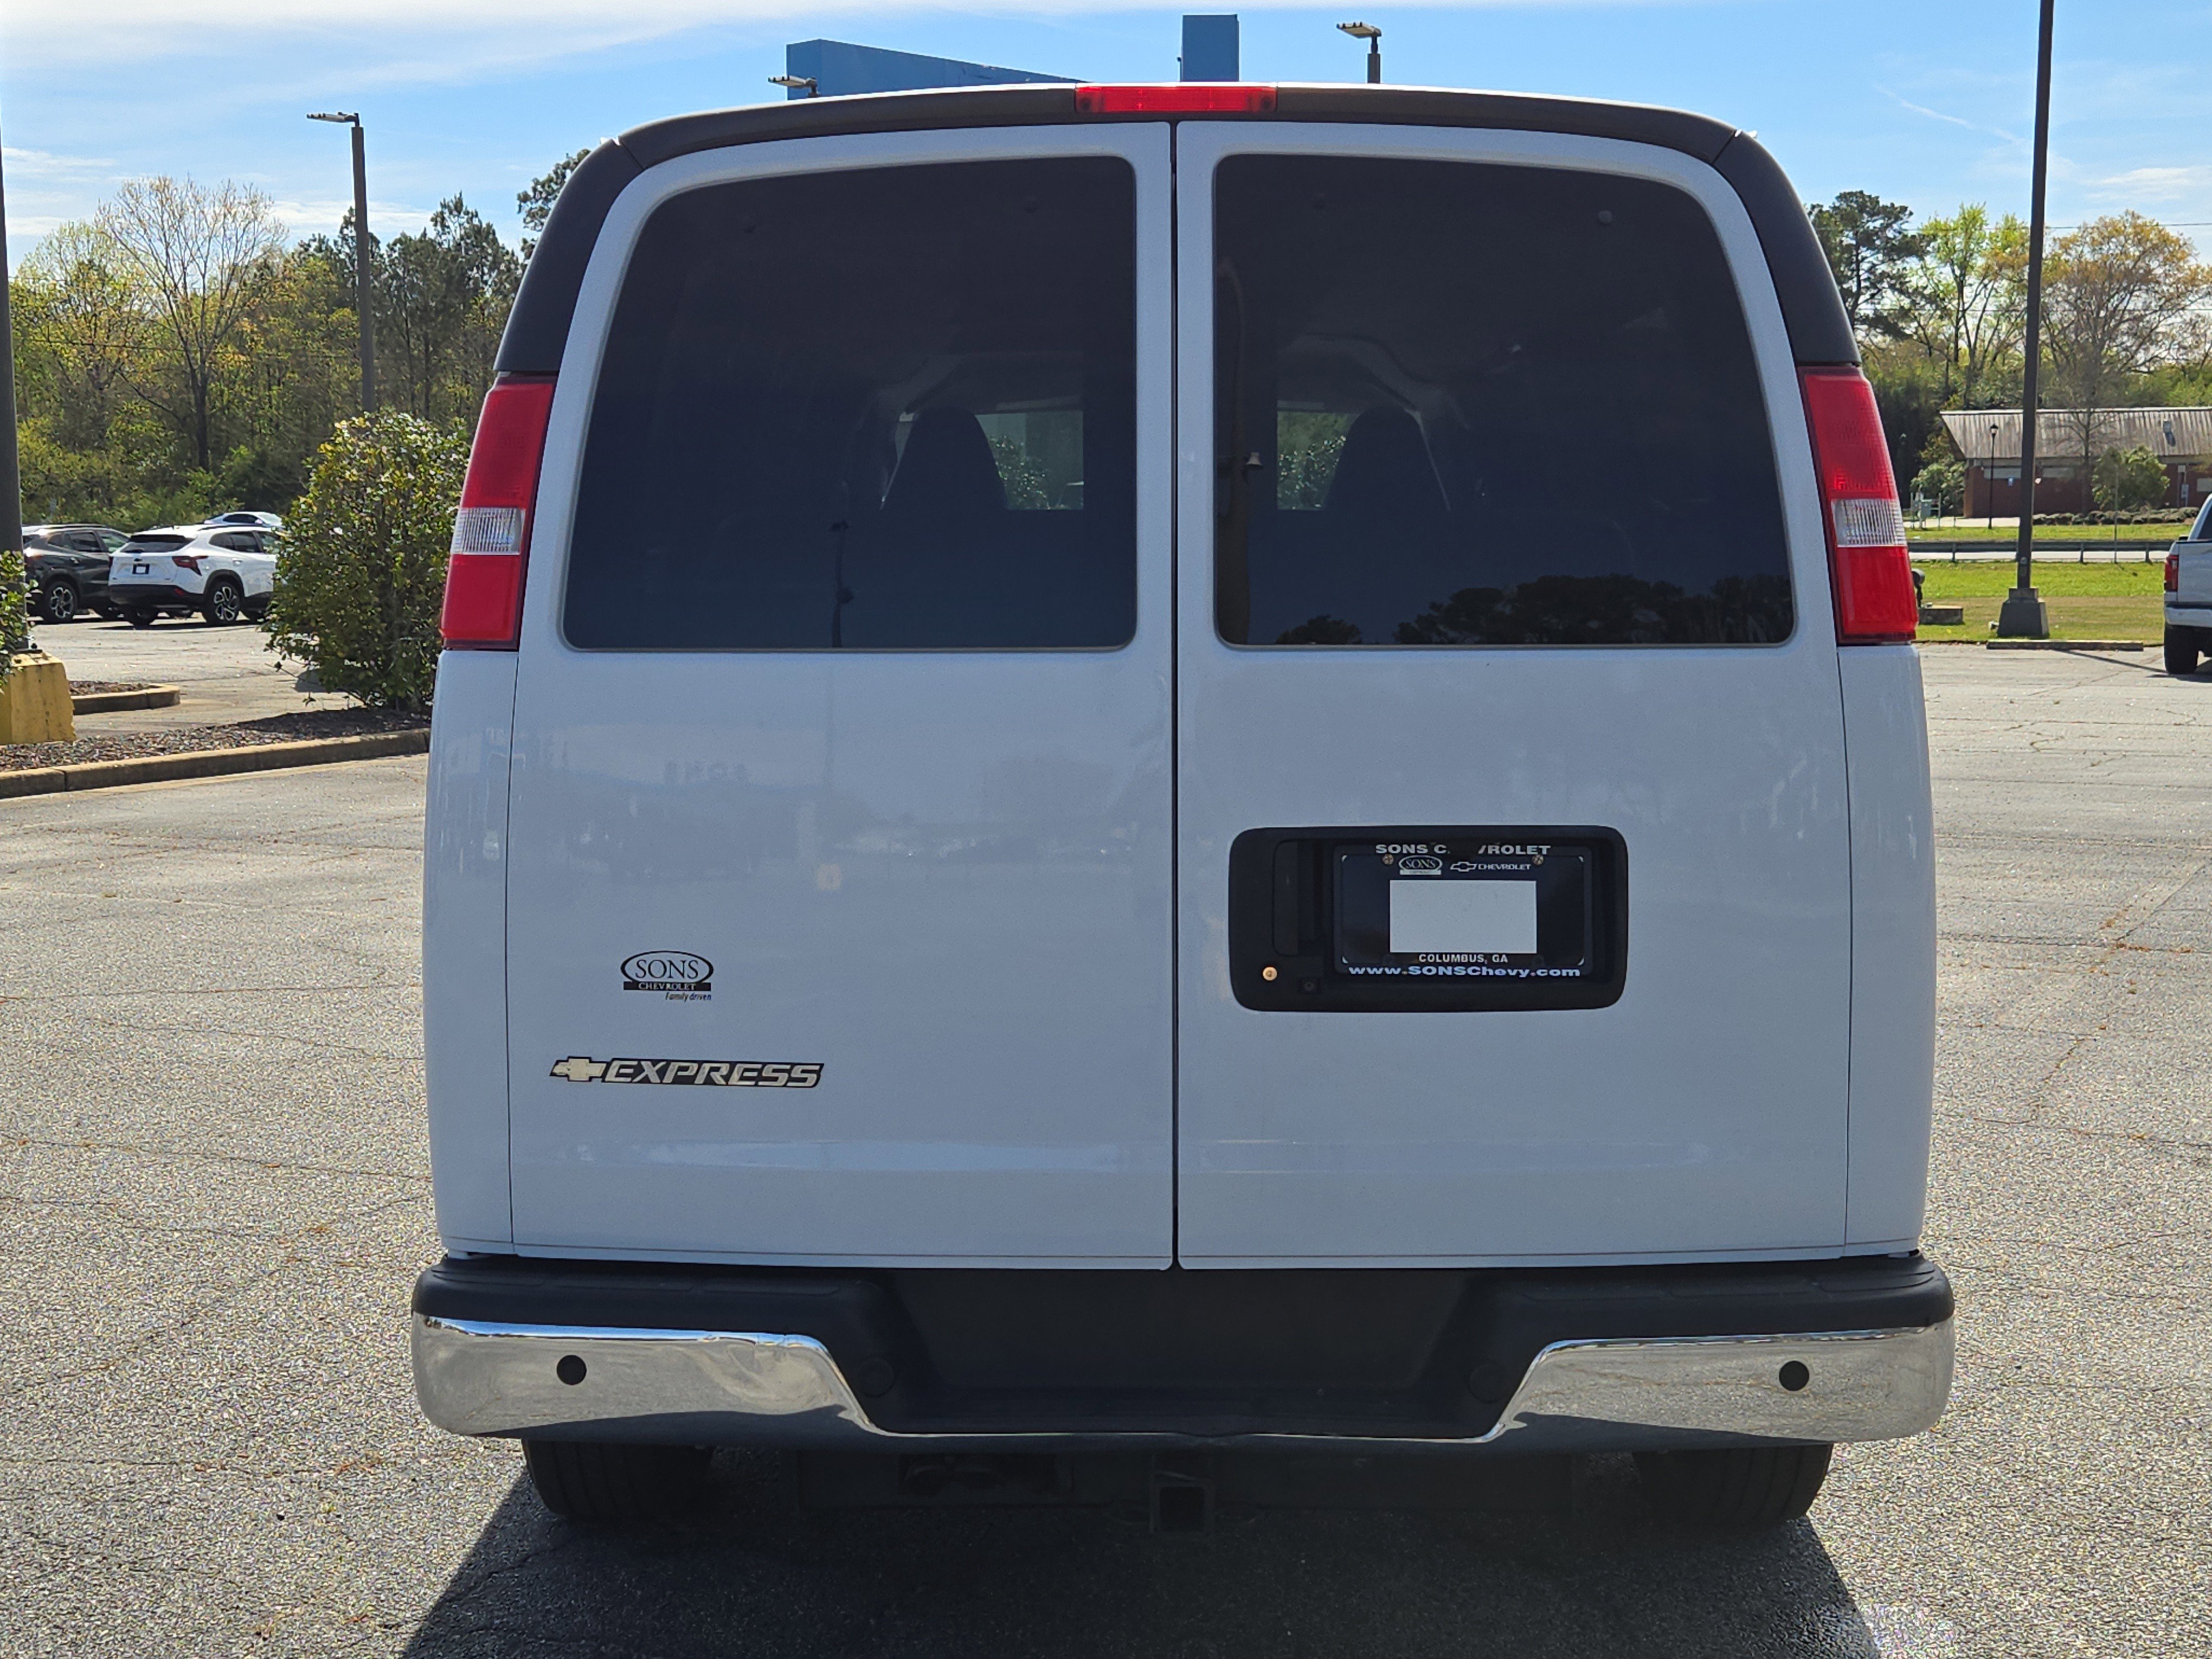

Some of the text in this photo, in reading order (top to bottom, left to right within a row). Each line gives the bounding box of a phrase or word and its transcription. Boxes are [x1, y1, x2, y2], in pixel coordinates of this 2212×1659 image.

[1375, 844, 1428, 854] SONS
[1405, 859, 1437, 869] SONS
[1418, 954, 1508, 964] COLUMBUS, GA
[635, 959, 699, 979] SONS
[1348, 966, 1580, 978] www.SONSChevy.com
[638, 983, 696, 991] CHEVROLET
[689, 992, 712, 1001] driven
[604, 1060, 822, 1088] EXPRESS
